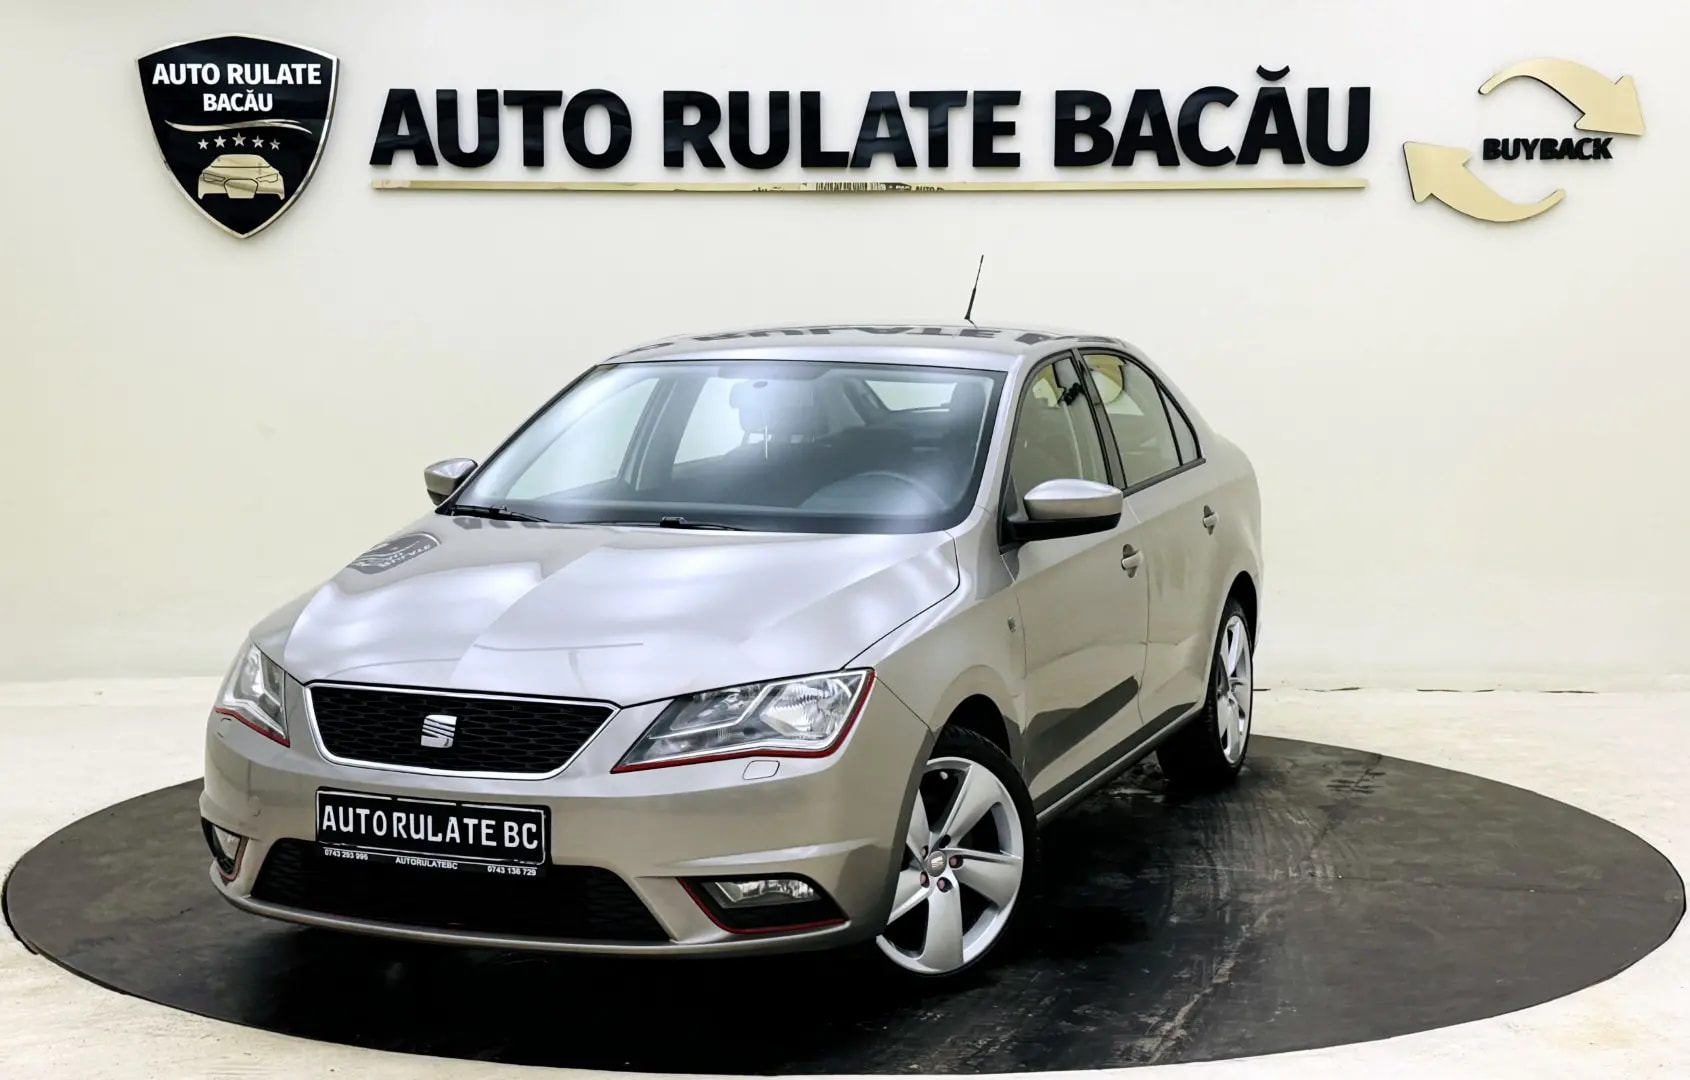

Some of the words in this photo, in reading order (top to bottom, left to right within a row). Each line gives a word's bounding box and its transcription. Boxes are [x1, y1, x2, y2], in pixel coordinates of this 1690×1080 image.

[152, 63, 220, 85] AUTO
[227, 63, 322, 85] RULATE
[203, 89, 273, 112] BACĂU
[369, 88, 632, 169] AUTO
[662, 89, 1021, 169] RULATE
[1054, 64, 1371, 168] BACĂU
[1482, 136, 1614, 161] BUYBACK
[322, 804, 388, 837] AUTO
[392, 811, 497, 847] RULATE
[503, 820, 539, 850] BC
[324, 849, 341, 858] 0743
[395, 856, 459, 870] AUTORULATEBC
[487, 865, 506, 874] 0743
